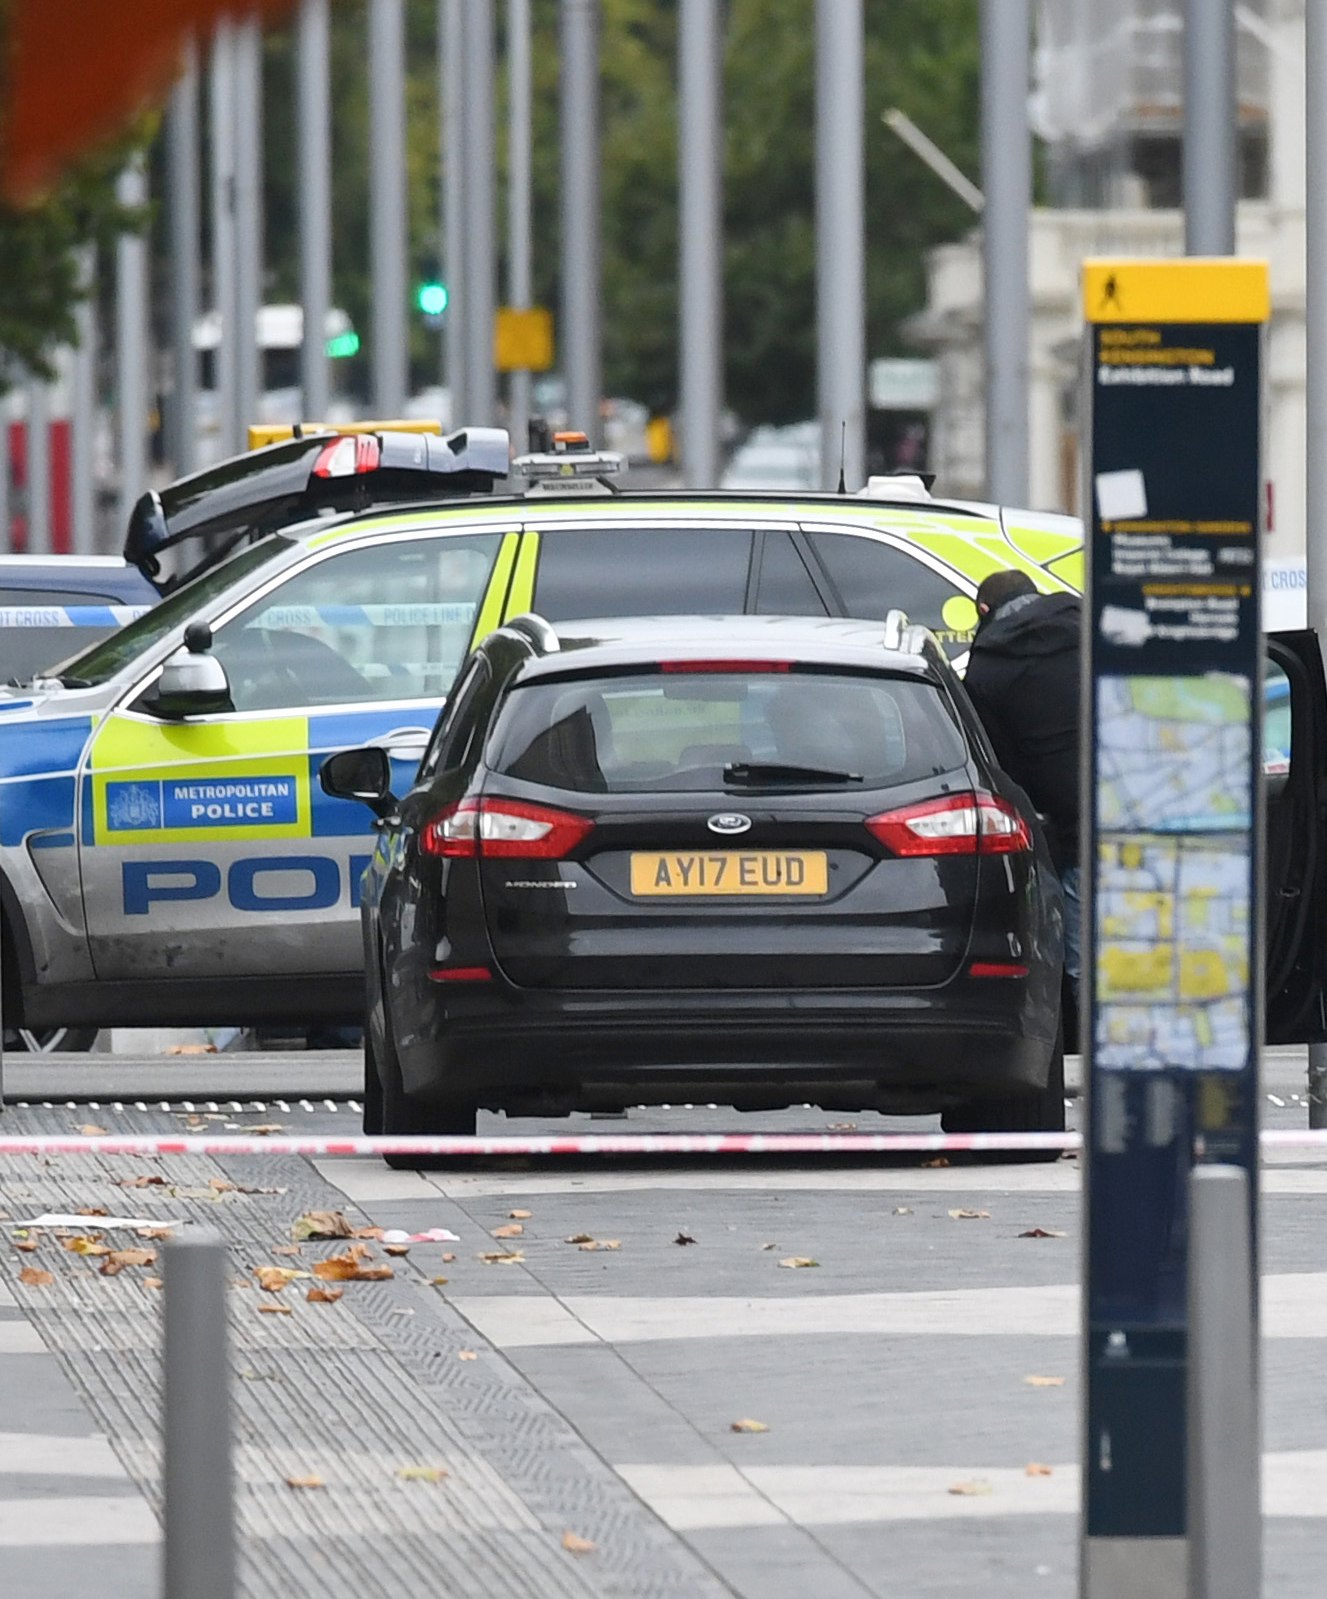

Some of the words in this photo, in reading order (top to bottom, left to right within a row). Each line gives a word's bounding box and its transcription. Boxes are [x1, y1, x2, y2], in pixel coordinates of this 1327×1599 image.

[1271, 570, 1305, 590] CROS
[15, 610, 60, 626] CROSS
[174, 782, 289, 800] METROPOLITAN
[191, 802, 274, 819] POLICE
[654, 856, 728, 888] AY17
[739, 856, 805, 887] EUD
